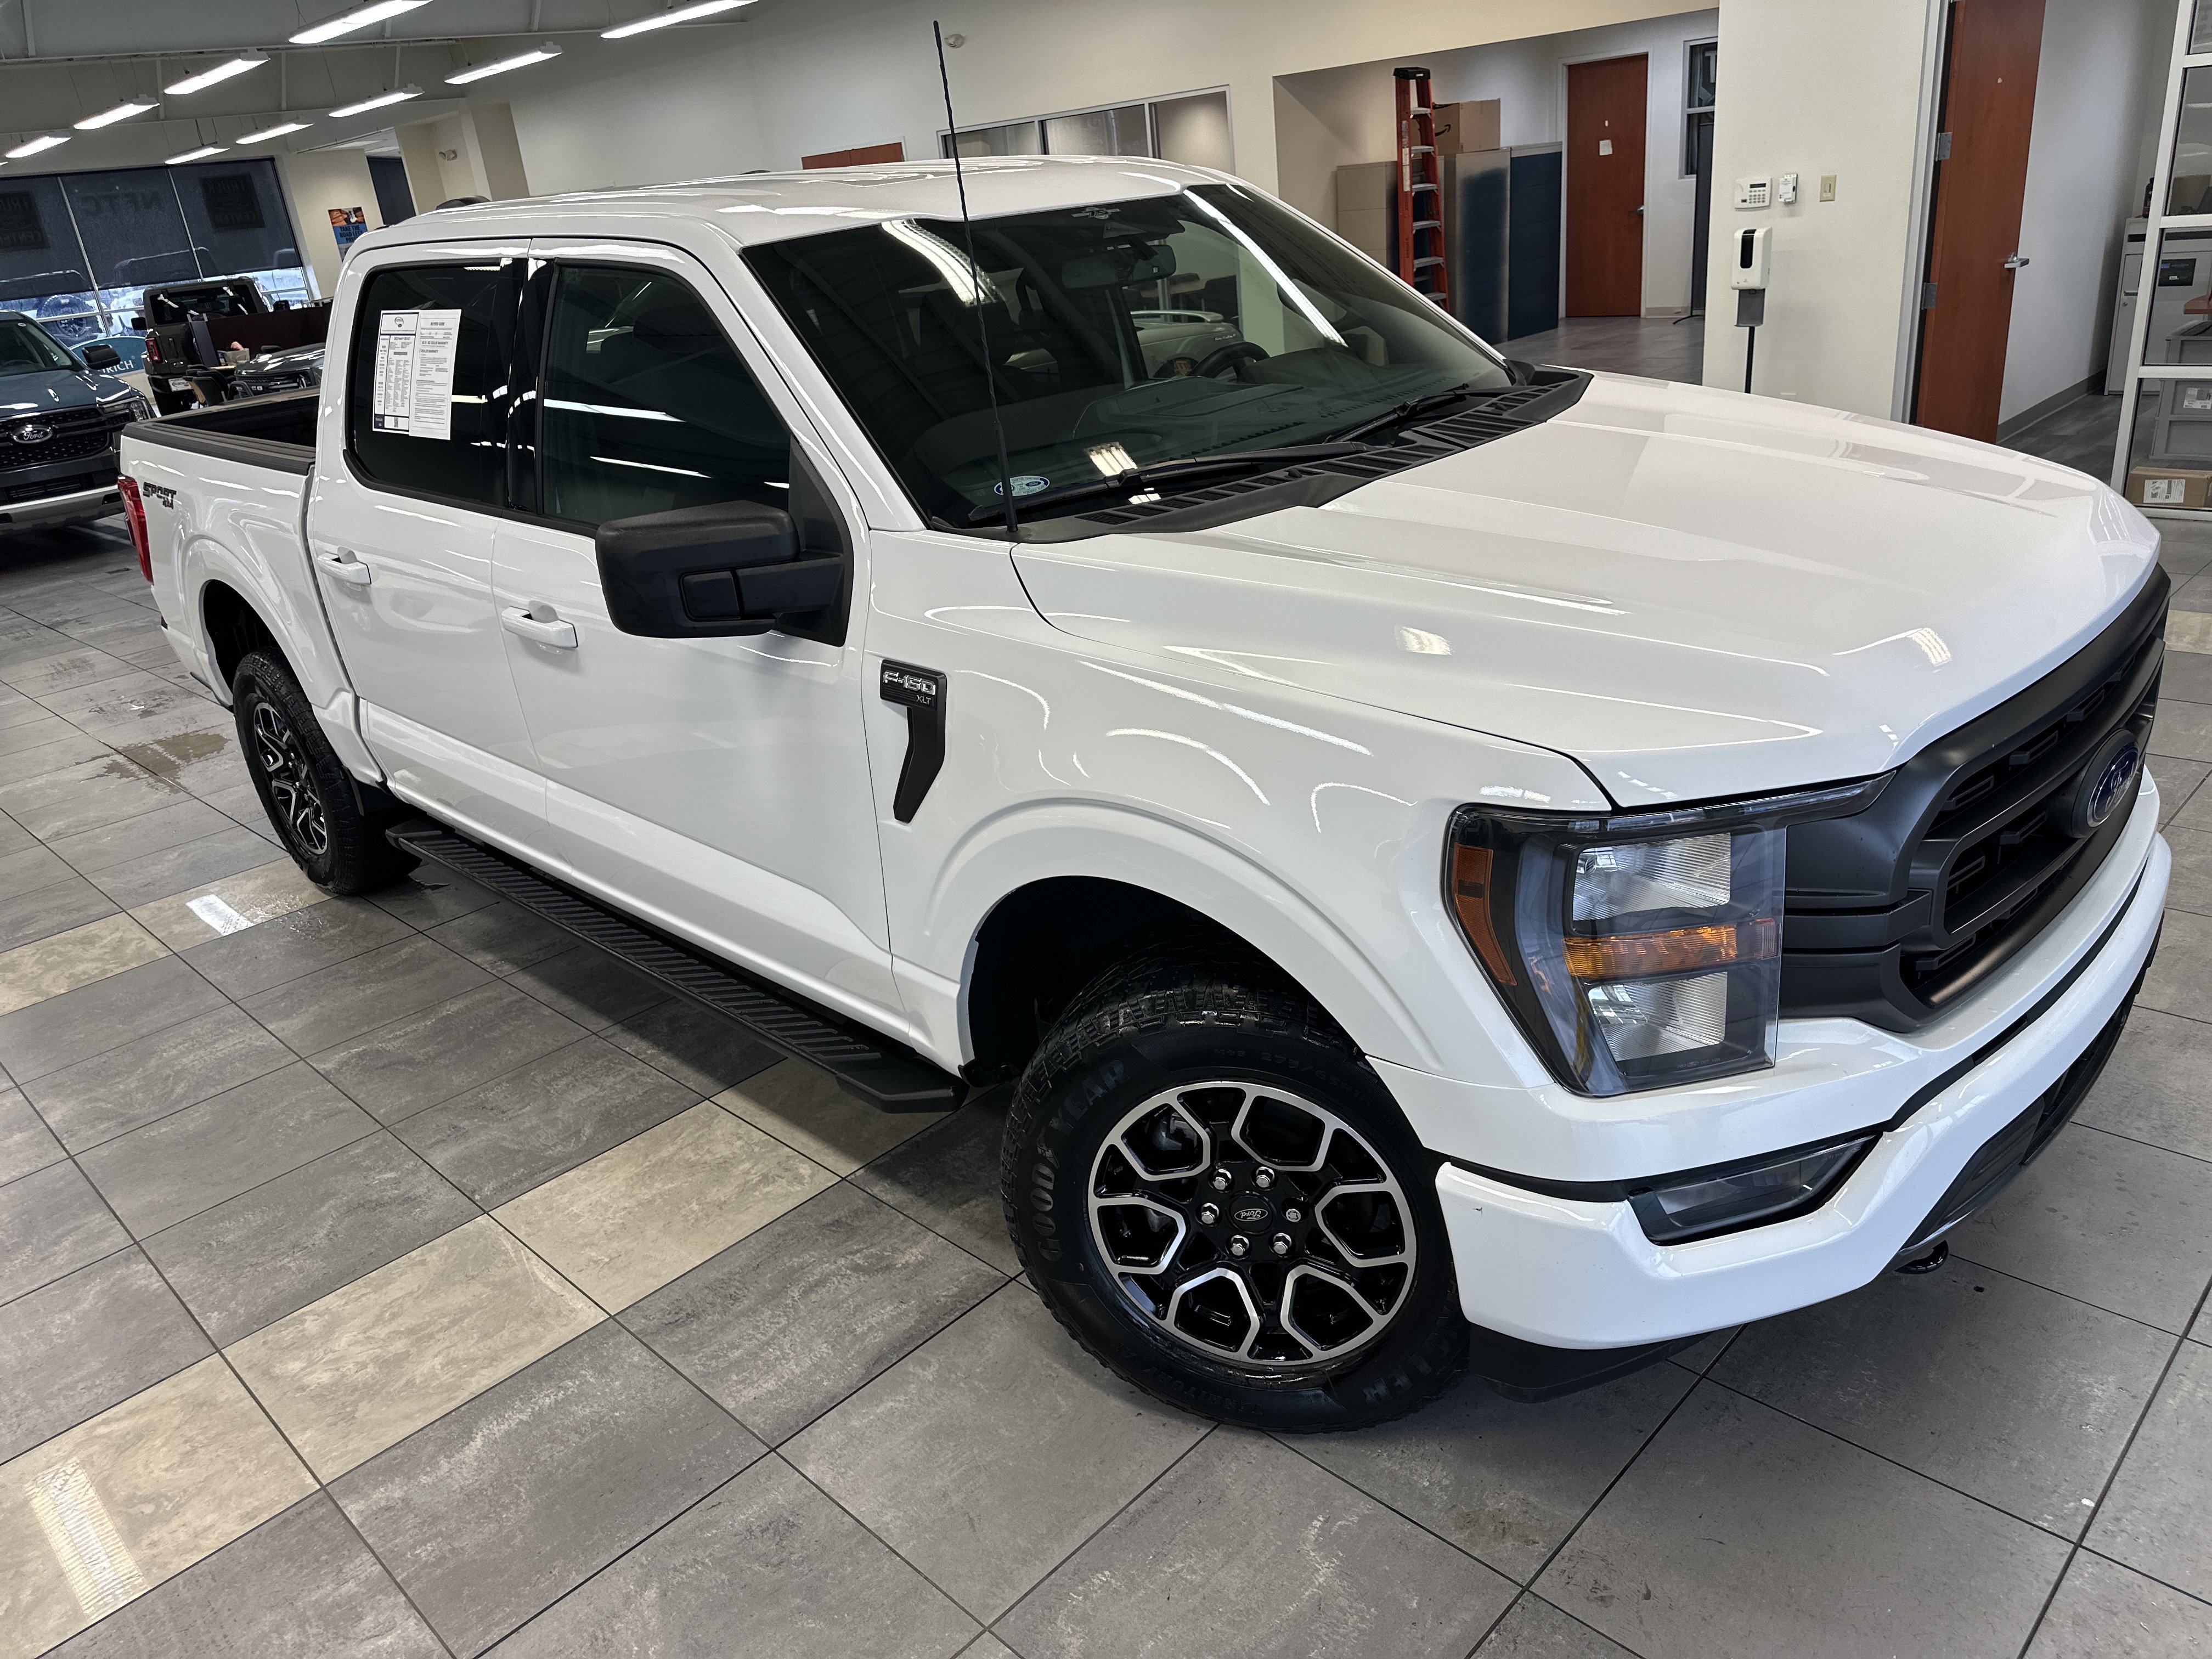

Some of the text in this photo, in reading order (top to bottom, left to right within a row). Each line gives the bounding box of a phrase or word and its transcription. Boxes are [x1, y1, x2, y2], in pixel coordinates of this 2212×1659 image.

[23, 430, 44, 441] Ford
[143, 482, 177, 499] SPORT
[883, 670, 936, 696] F-150
[916, 695, 932, 706] XLT
[1239, 1210, 1261, 1220] Ford
